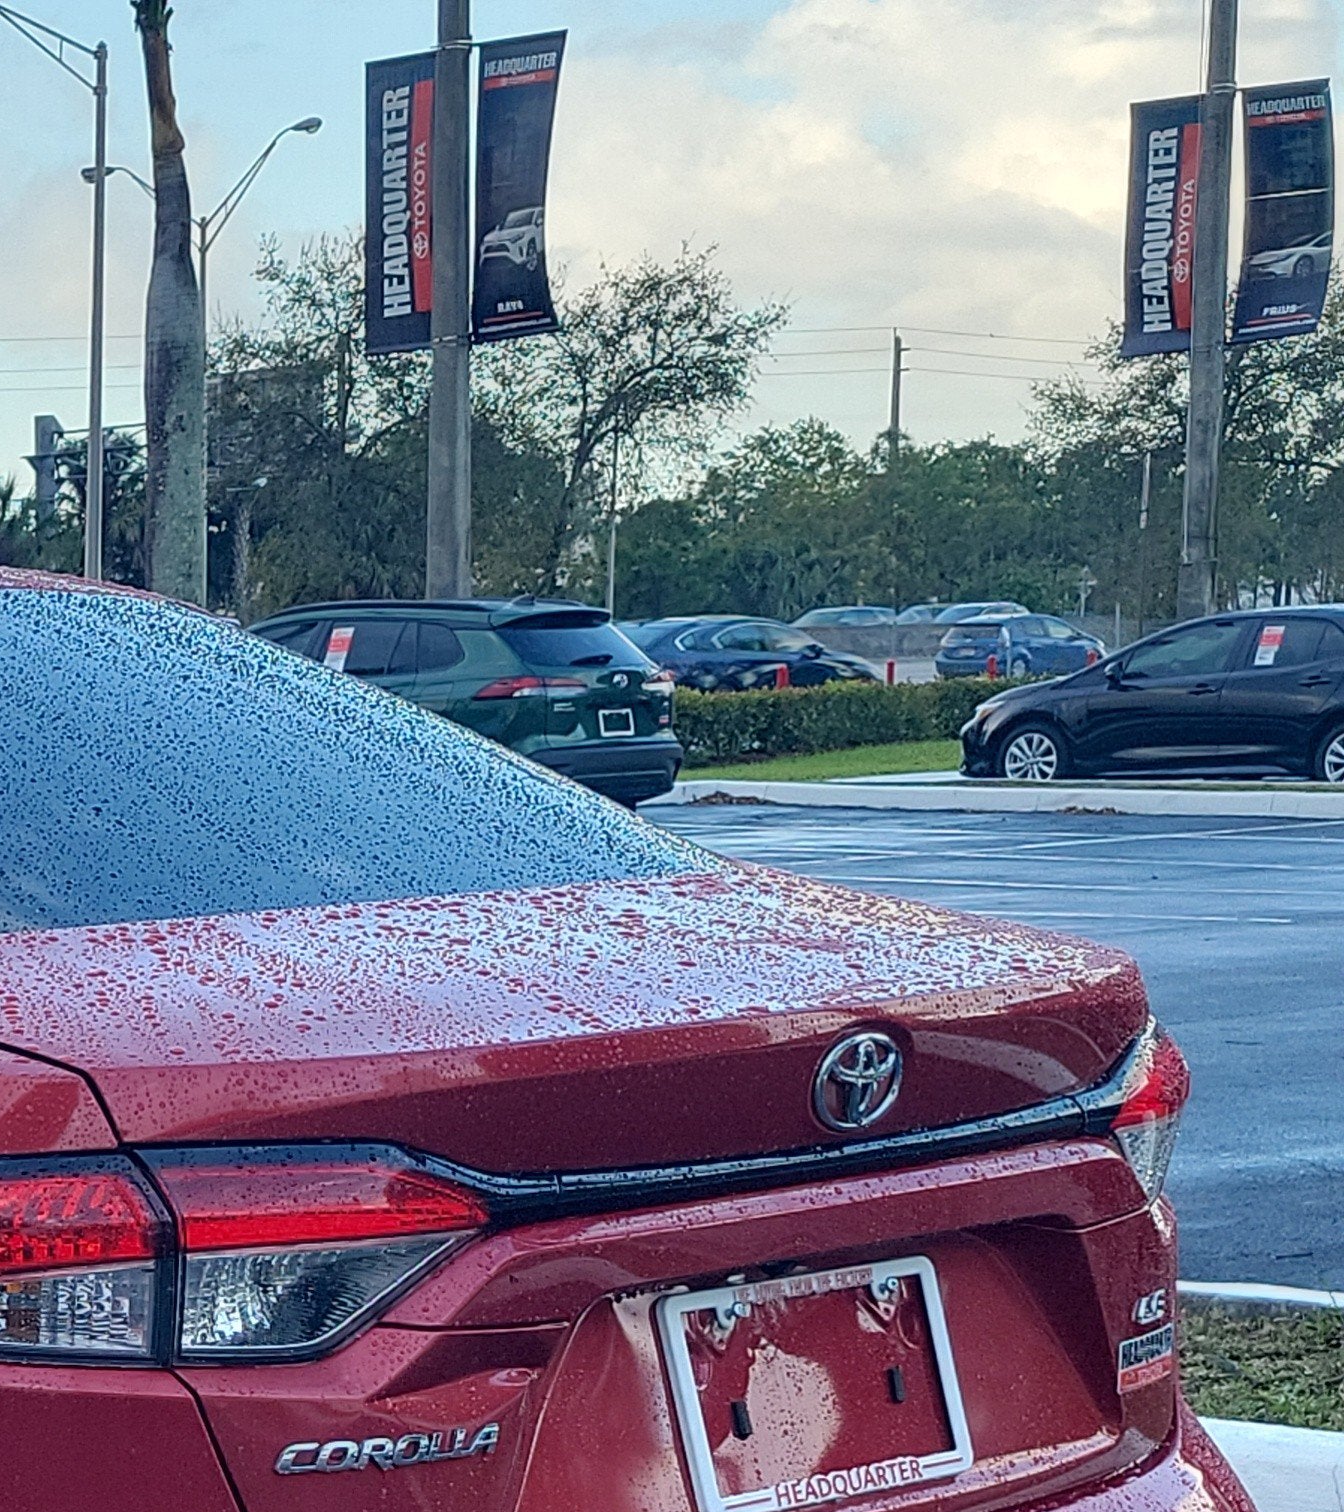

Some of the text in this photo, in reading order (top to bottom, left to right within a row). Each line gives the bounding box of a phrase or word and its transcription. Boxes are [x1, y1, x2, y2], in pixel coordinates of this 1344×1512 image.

[382, 85, 412, 319] HEADQUARTER
[411, 142, 428, 230] TOYOTA
[1176, 178, 1196, 256] TOYOTA
[1142, 127, 1178, 333] HEADQUARTER
[1131, 1288, 1167, 1325] LE
[275, 1422, 499, 1475] COROLLA
[774, 1459, 924, 1508] HEADQUARTER
